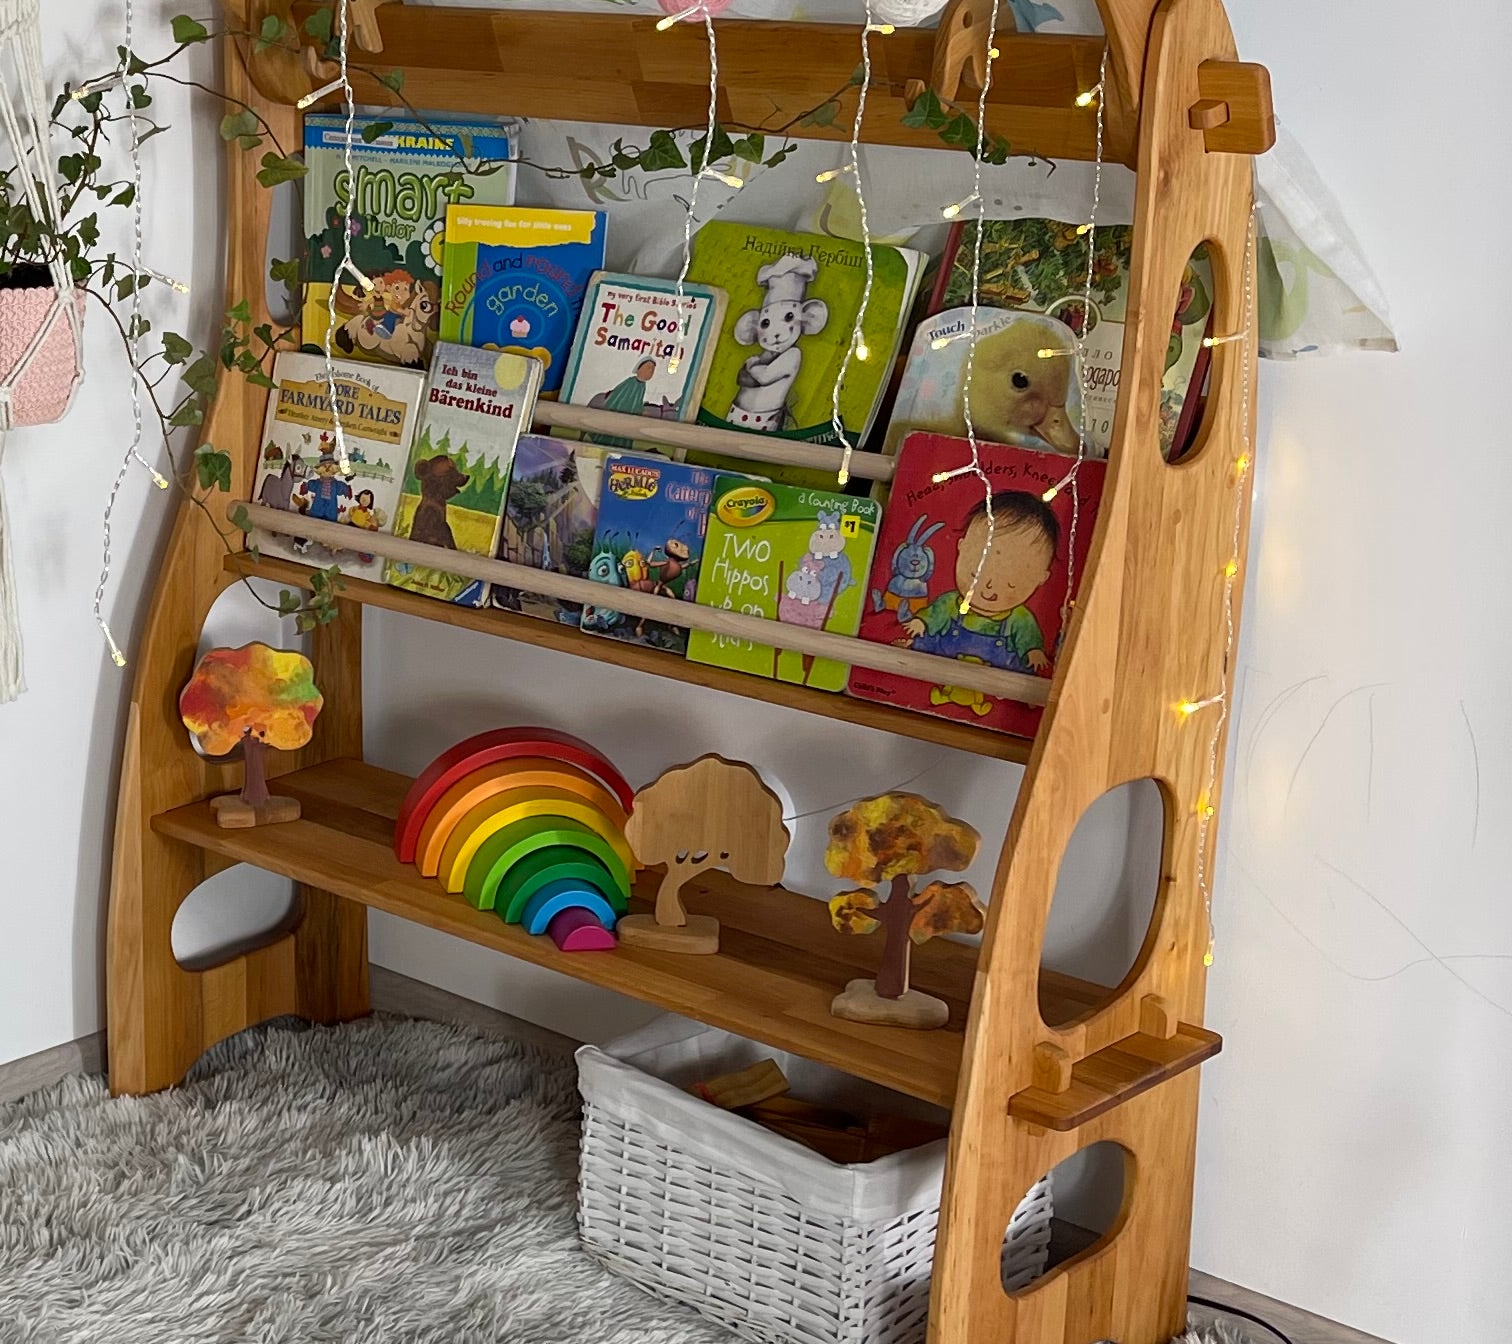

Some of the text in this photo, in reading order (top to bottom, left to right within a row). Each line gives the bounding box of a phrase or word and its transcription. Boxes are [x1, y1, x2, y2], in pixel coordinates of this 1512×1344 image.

[334, 164, 475, 222] smart
[364, 214, 416, 240] junior
[492, 252, 523, 272] and
[486, 283, 559, 317] garden
[618, 292, 633, 303] very
[635, 294, 651, 305] first
[652, 296, 669, 307] Bible
[602, 302, 635, 327] The
[928, 314, 1012, 341] Touch parkle
[441, 364, 478, 380] Ich bin
[445, 378, 498, 398] das kleine
[358, 402, 402, 426] TALES
[428, 387, 514, 419] Bärenkind
[1022, 459, 1061, 487] Knee
[726, 495, 767, 509] Crayola
[798, 493, 806, 504] a
[850, 498, 876, 515] Book
[844, 519, 856, 534] $1
[711, 556, 769, 597] Hippos
